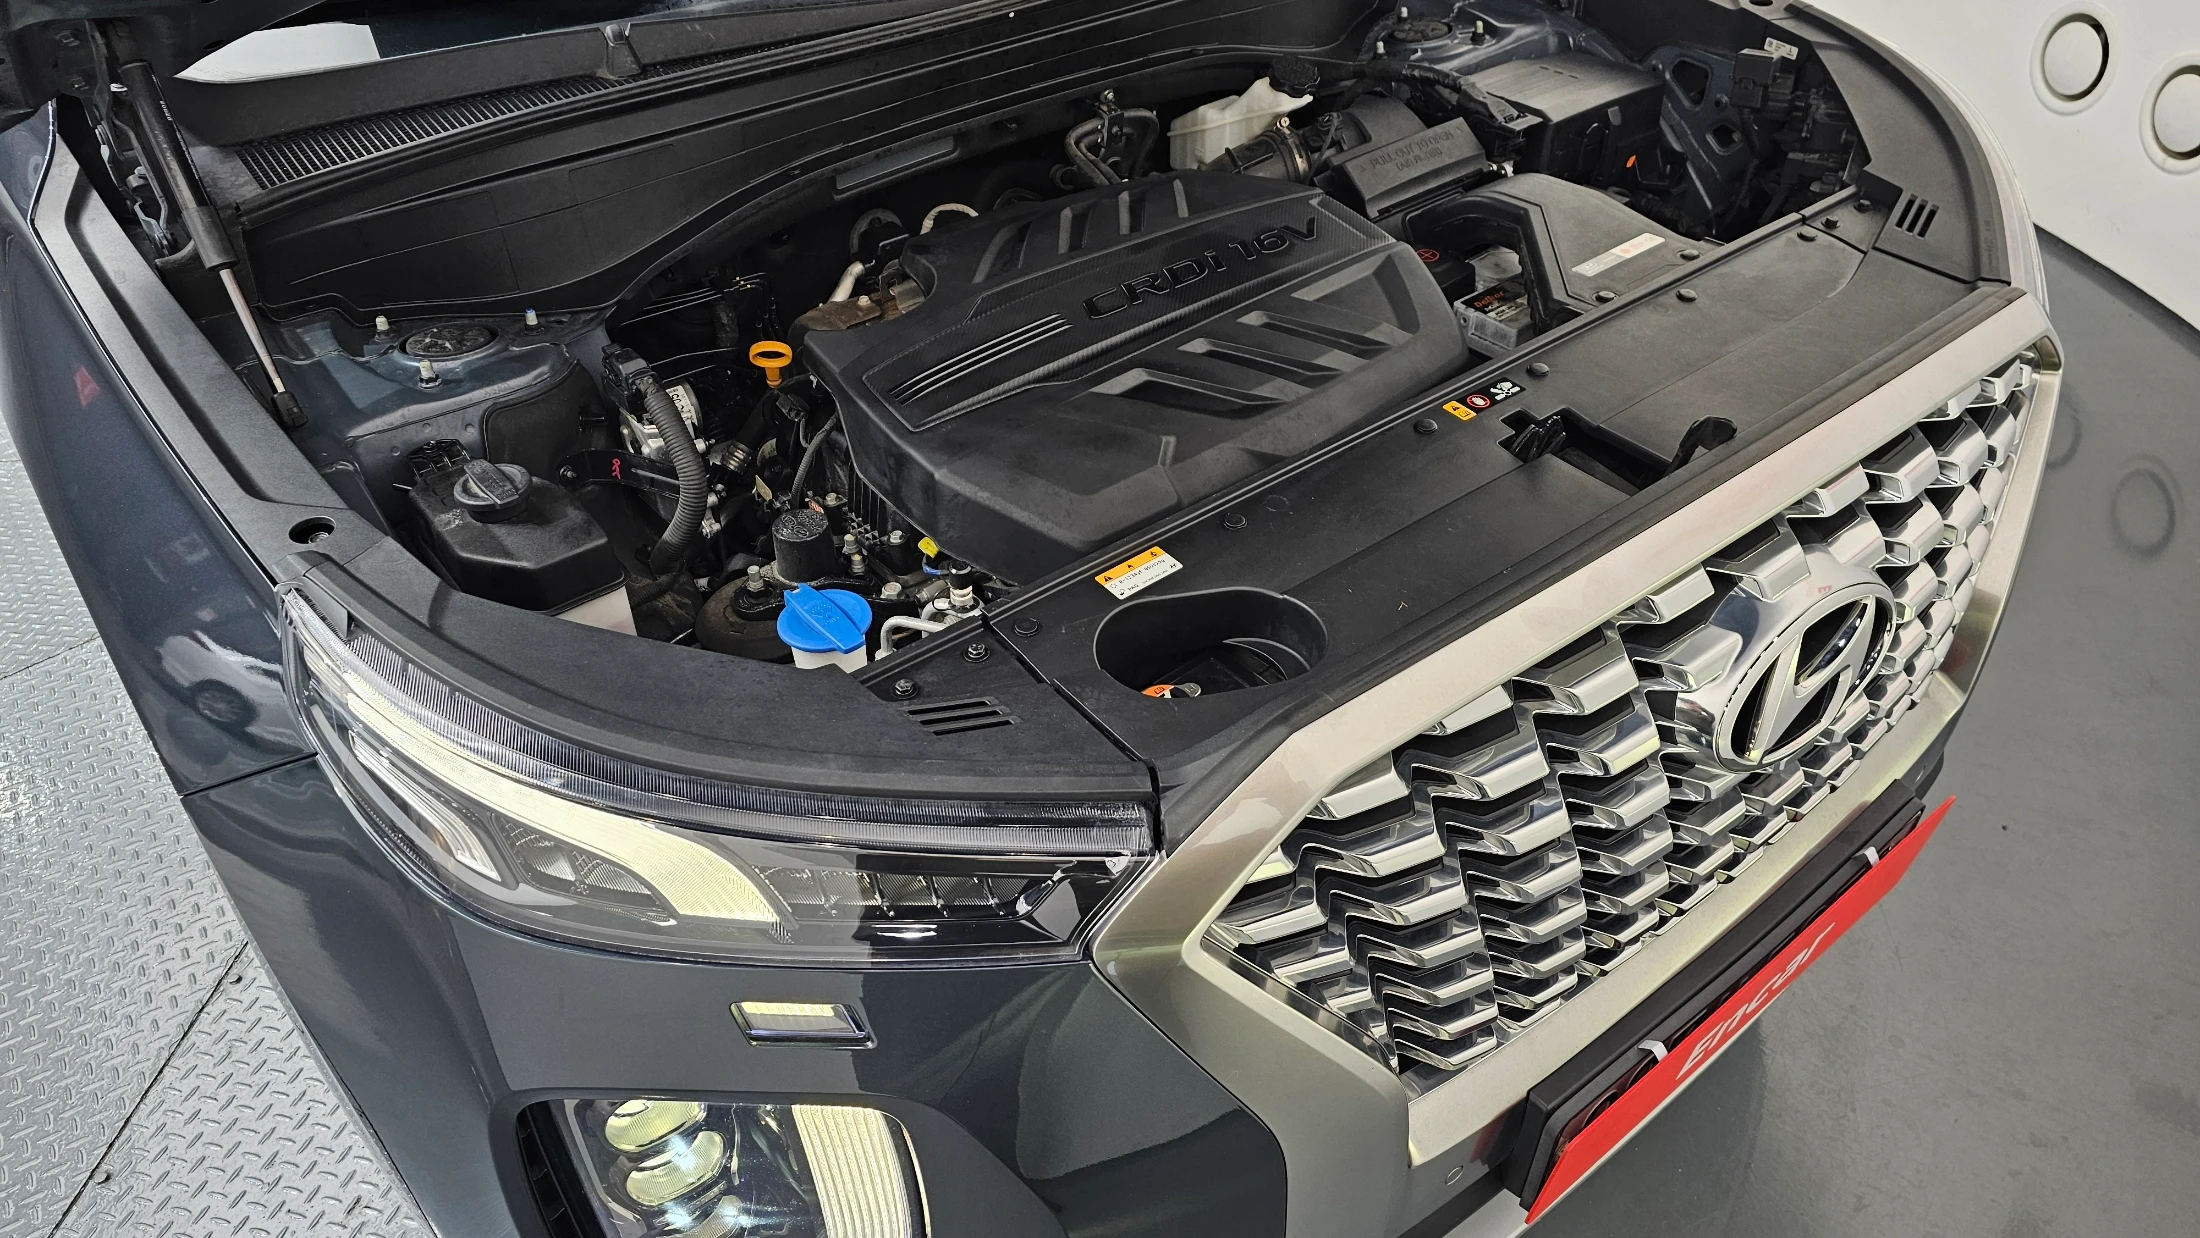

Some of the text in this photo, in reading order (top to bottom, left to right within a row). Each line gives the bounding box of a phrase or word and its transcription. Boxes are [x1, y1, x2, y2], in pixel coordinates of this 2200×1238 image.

[1370, 152, 1394, 169] PULL
[1395, 145, 1415, 160] OUT
[1083, 216, 1317, 319] CRDi 16V
[1675, 921, 1836, 1081] Encar
